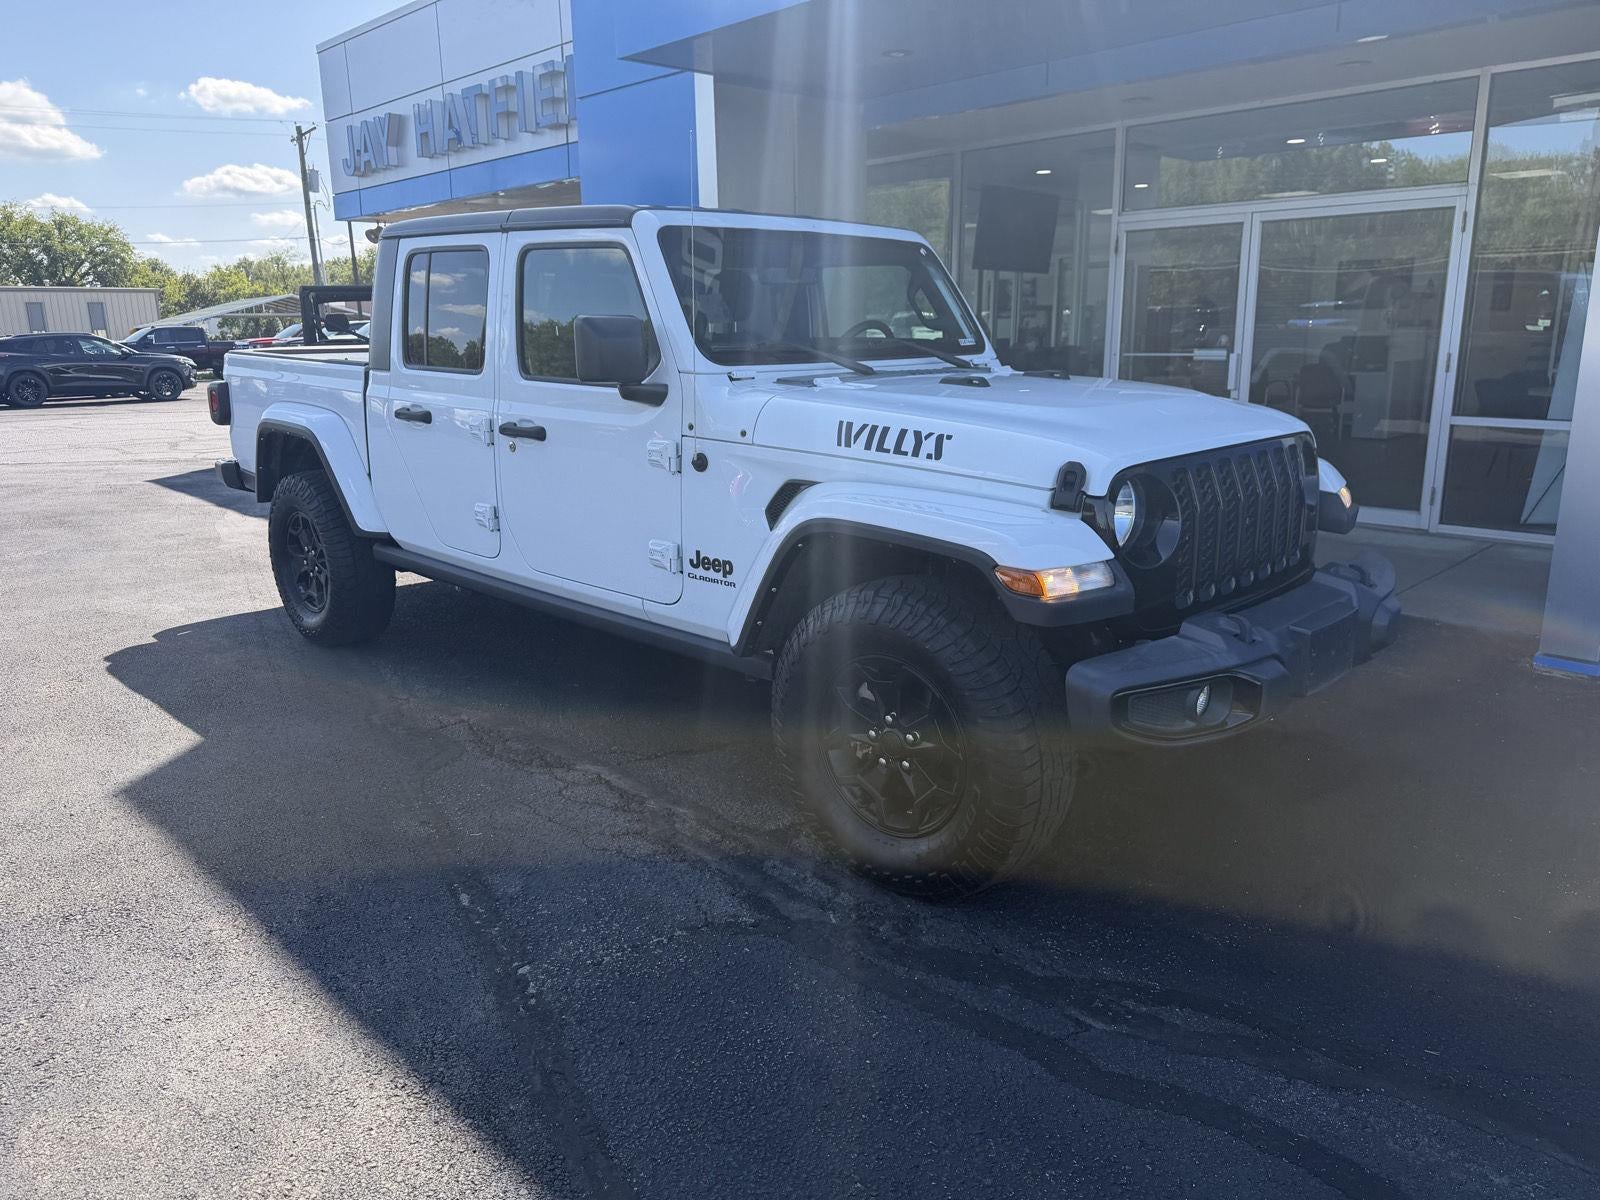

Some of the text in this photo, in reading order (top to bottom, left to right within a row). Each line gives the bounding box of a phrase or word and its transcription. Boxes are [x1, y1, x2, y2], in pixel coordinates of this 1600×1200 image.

[341, 112, 399, 177] JAY
[836, 420, 954, 461] WILLYS
[687, 572, 737, 589] GLADIATOR
[689, 549, 734, 579] Jeep
